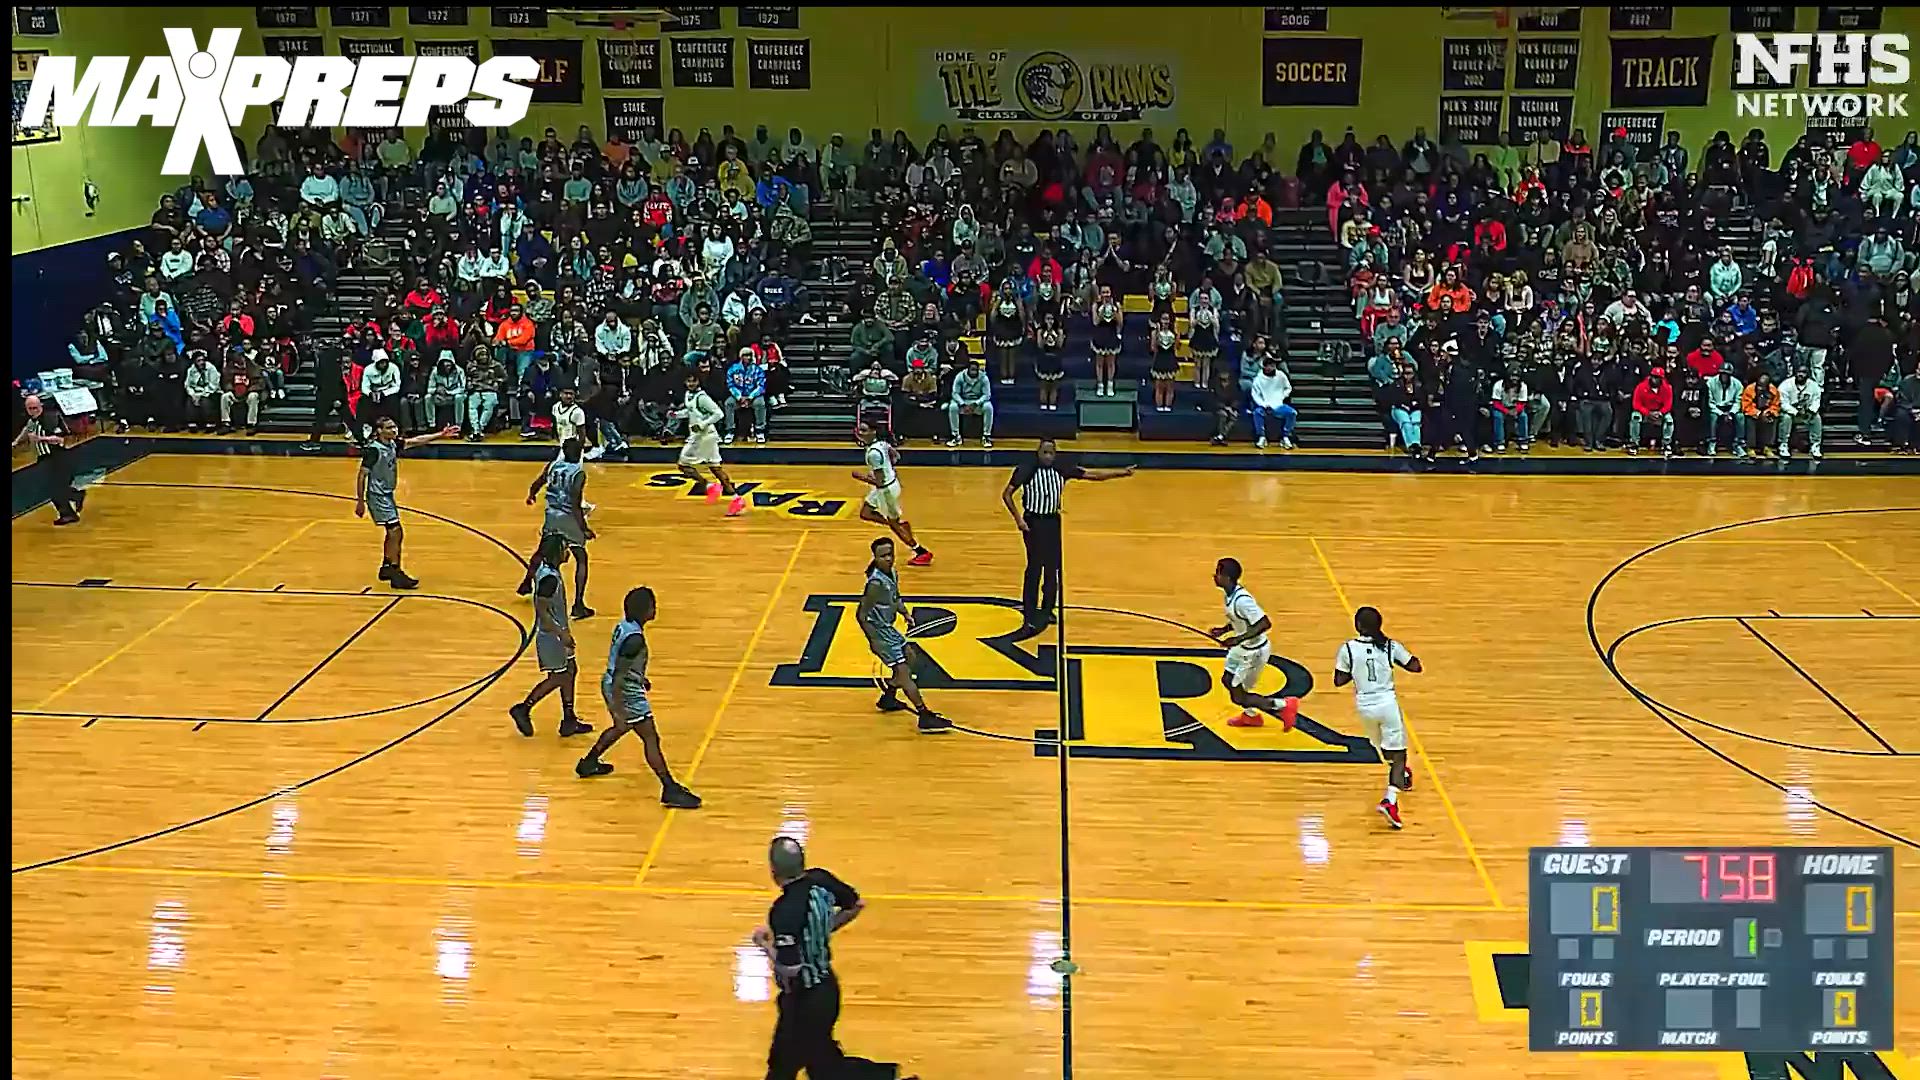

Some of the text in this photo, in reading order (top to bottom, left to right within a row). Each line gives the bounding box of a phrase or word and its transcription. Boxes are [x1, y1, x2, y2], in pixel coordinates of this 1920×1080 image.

[508, 13, 530, 24] 1973
[1281, 15, 1310, 26] 2006
[677, 43, 728, 54] CONFERENCE
[754, 44, 804, 56] CONFERENCE
[681, 57, 725, 68] CHAMPIONS
[935, 52, 1007, 62] HOME OF
[758, 59, 801, 71] CHAMPIONS
[1275, 62, 1347, 83] SOCCER
[1622, 56, 1700, 88] TRACK
[939, 62, 1175, 111] THE RAMS
[623, 102, 646, 113] STATE
[614, 116, 656, 127] CHAMPIONS
[1607, 117, 1657, 128] CONFERENCE
[1366, 658, 1377, 682] 1
